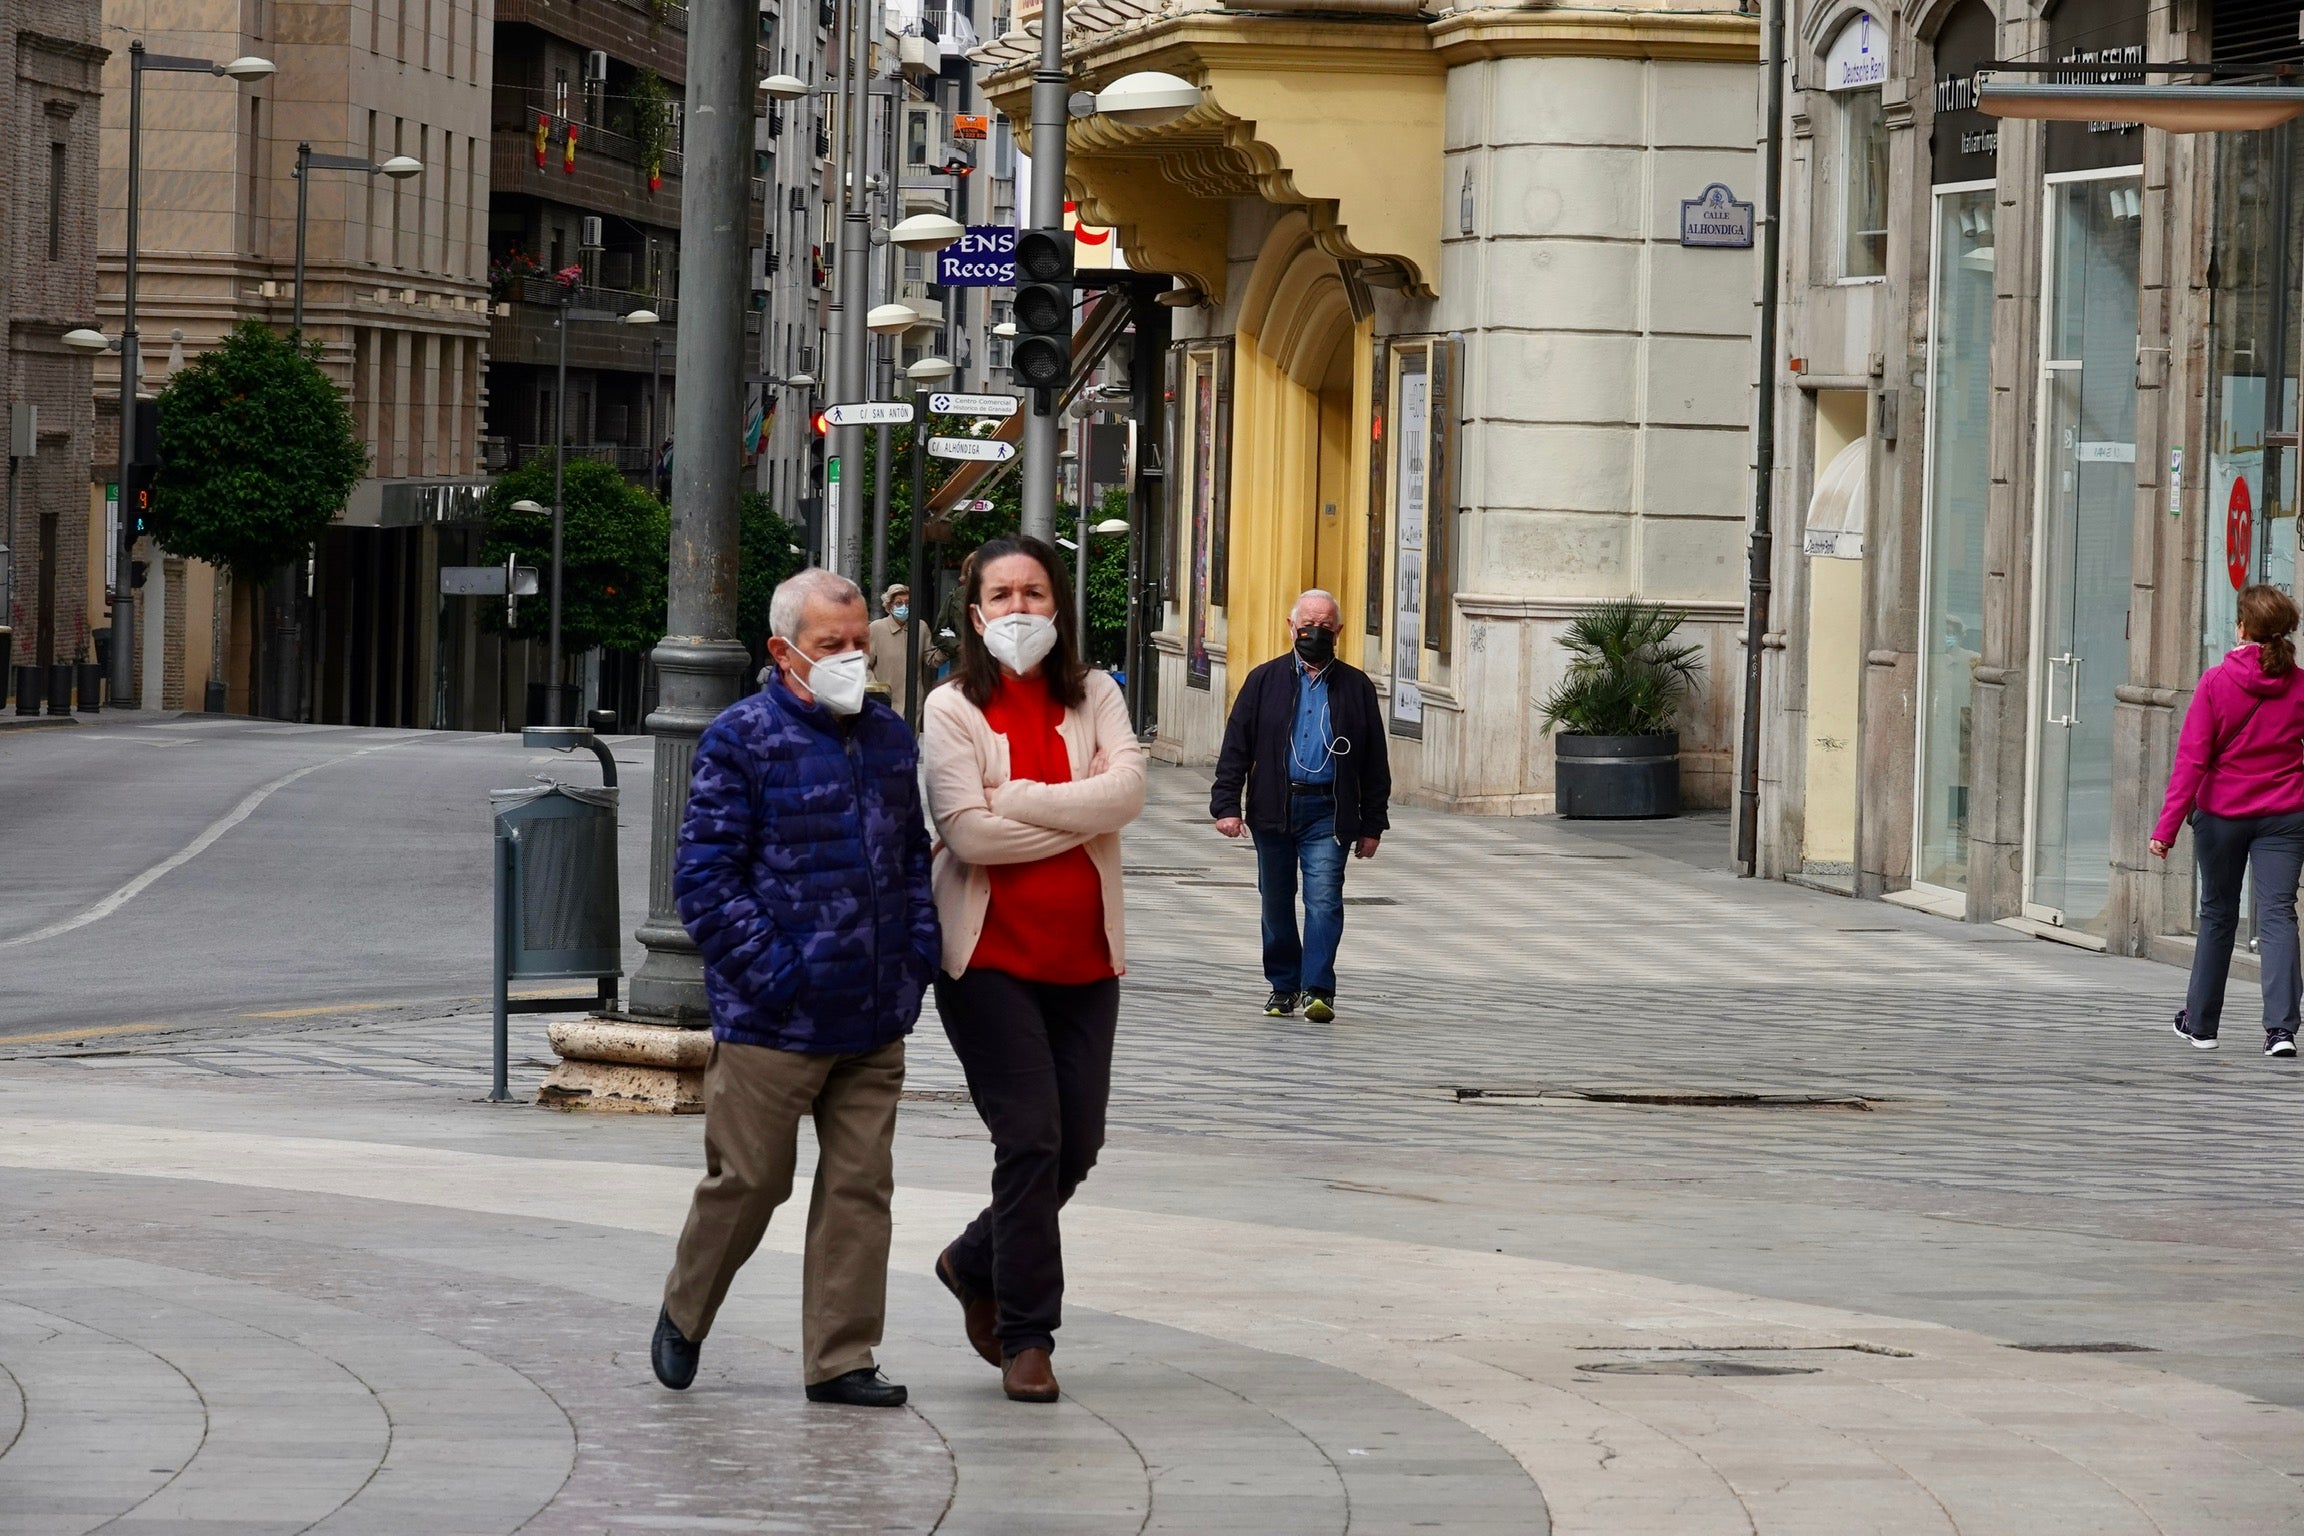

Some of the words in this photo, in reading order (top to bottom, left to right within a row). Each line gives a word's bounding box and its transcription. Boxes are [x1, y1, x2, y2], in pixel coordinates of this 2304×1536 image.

[1843, 58, 1869, 84] Deutsche
[1870, 56, 1885, 80] Bank
[1703, 211, 1730, 220] CALLE
[1687, 223, 1744, 235] ALHONDIGA
[954, 397, 977, 405] Centro
[860, 408, 868, 419] C/
[873, 408, 885, 418] SAN
[889, 405, 909, 418] ANTÓN
[931, 443, 939, 452] C/
[944, 442, 980, 455] ALHÓNDIGA
[140, 490, 147, 509] 9
